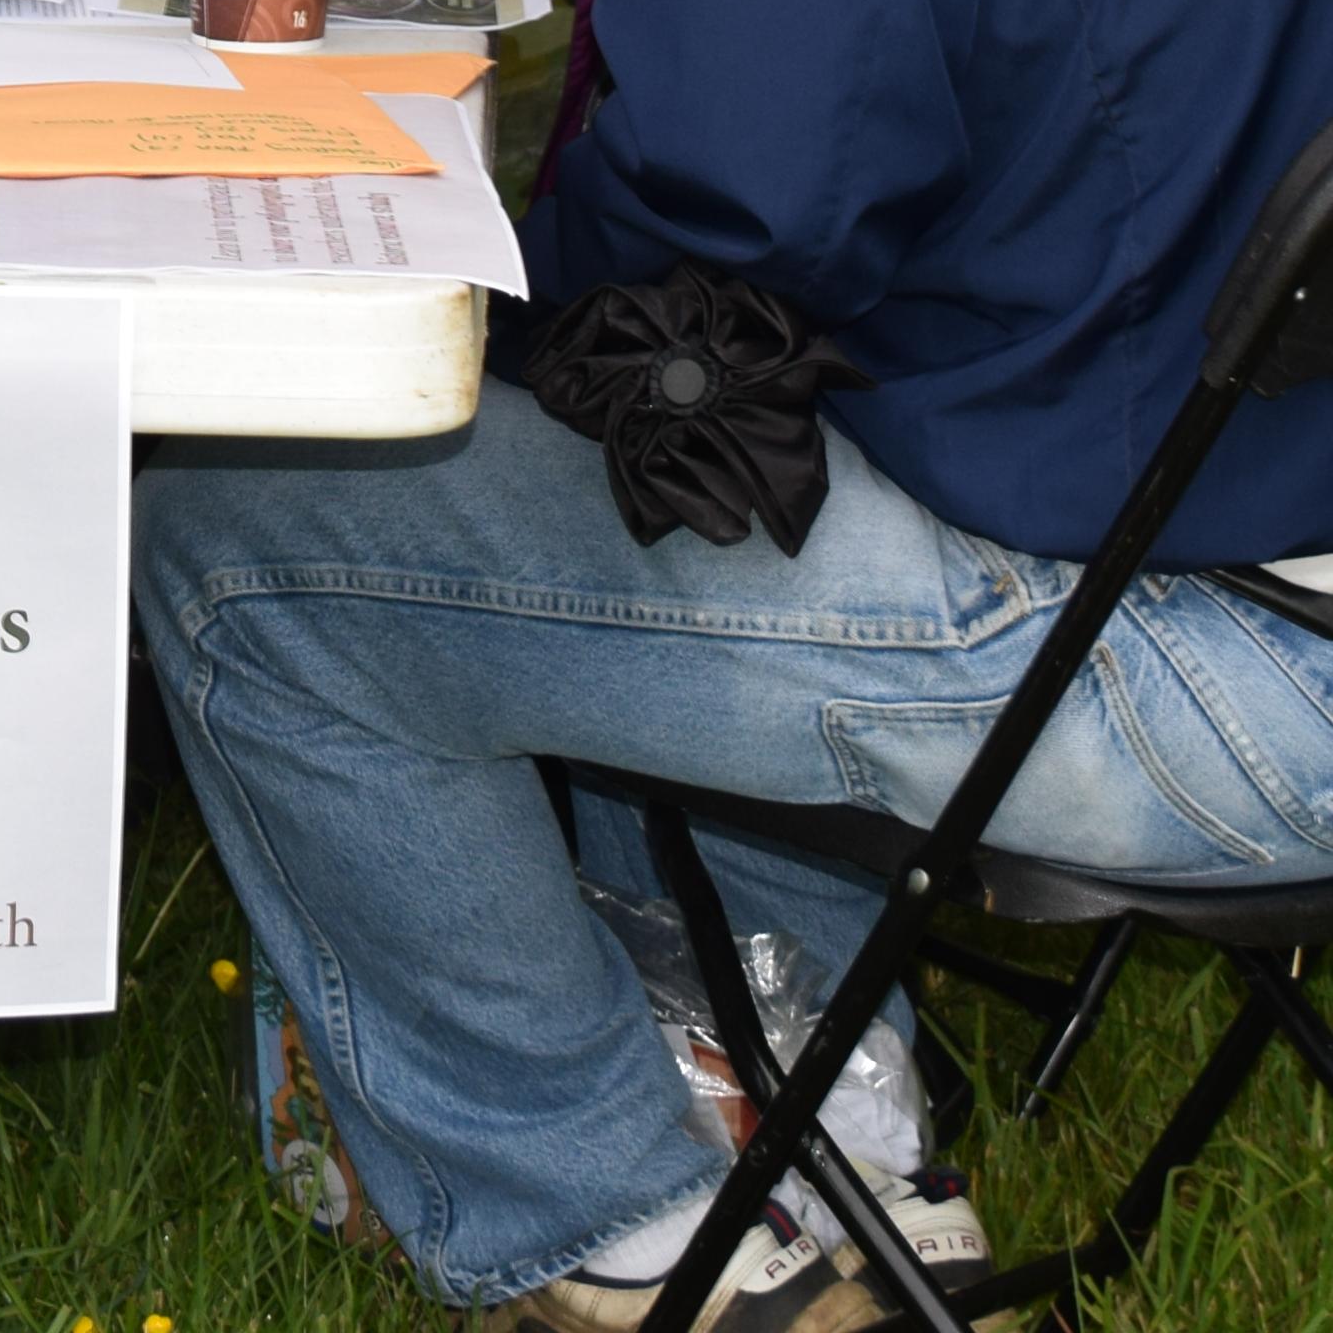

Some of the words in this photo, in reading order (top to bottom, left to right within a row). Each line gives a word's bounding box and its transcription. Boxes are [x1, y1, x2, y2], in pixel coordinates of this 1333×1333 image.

[293, 10, 308, 28] 16
[917, 1235, 978, 1255] AIR
[765, 1239, 815, 1279] AIR
